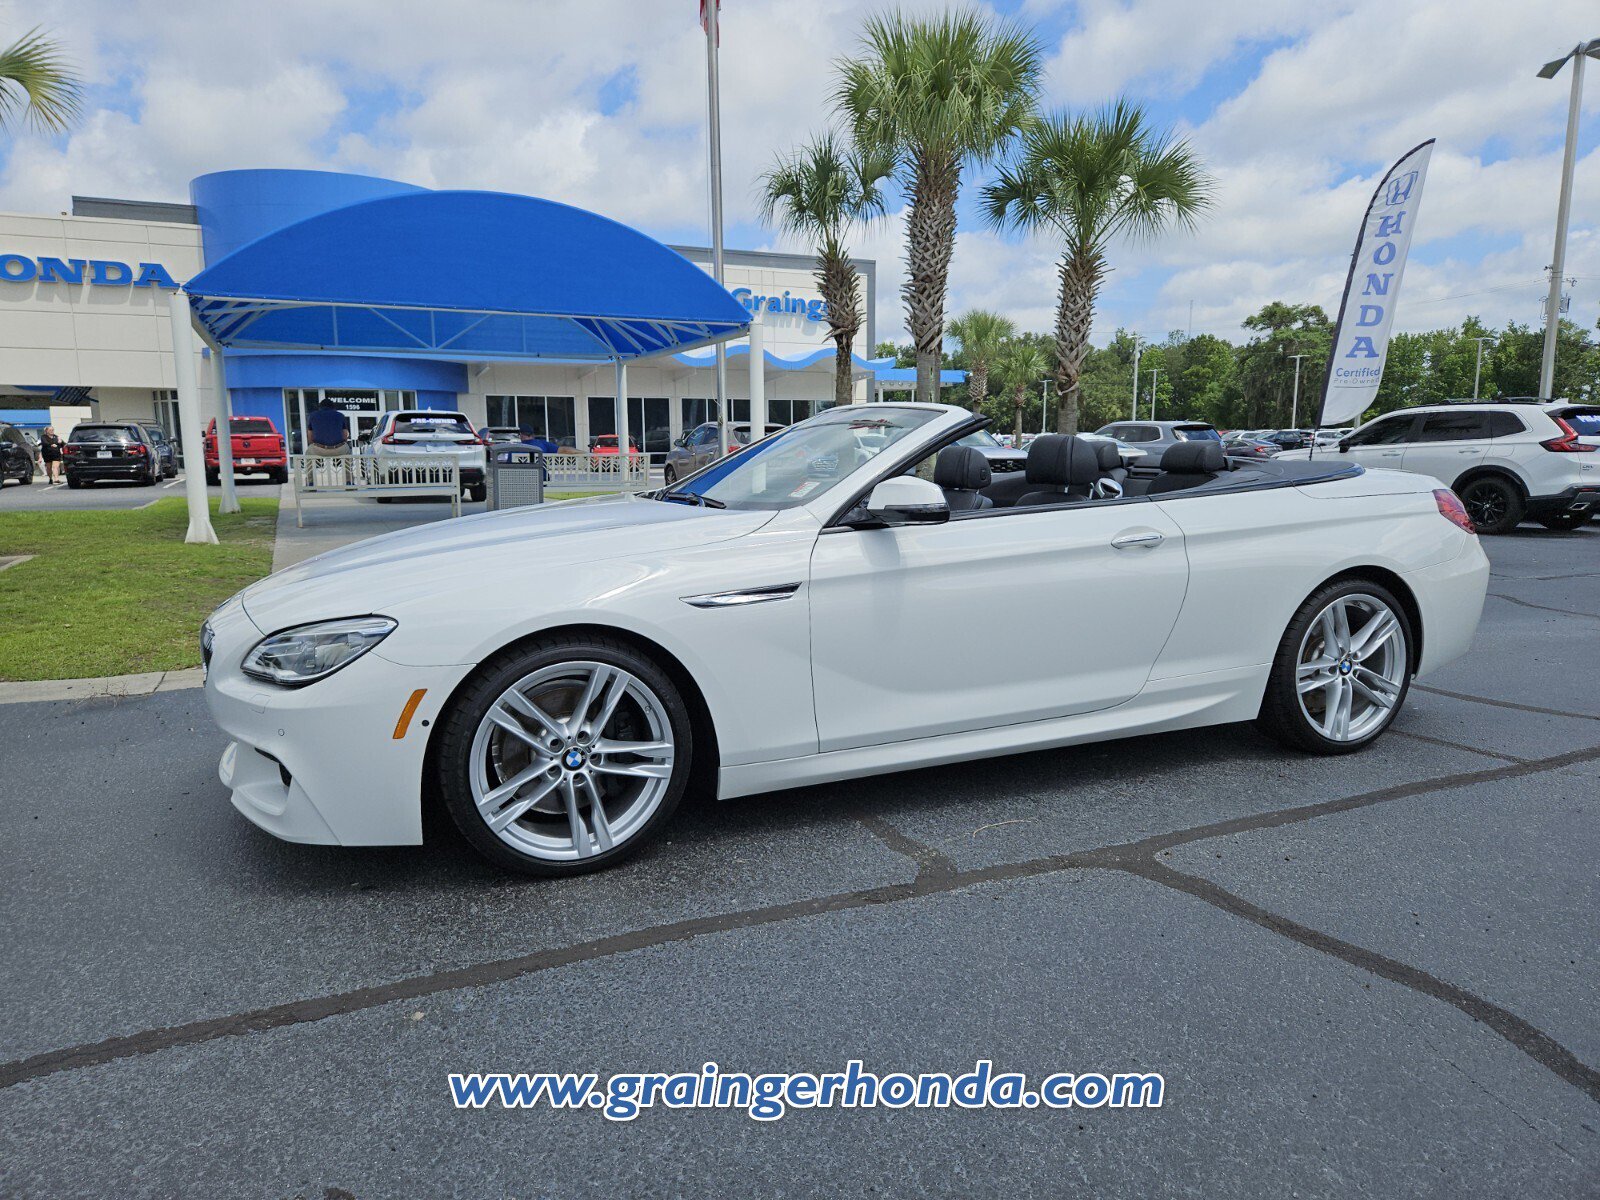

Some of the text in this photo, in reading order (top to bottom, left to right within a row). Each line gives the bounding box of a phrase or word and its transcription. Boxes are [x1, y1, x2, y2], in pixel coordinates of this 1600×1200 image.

[0, 254, 181, 288] ONDA
[1346, 210, 1406, 358] HONDA
[1336, 366, 1381, 377] Certified
